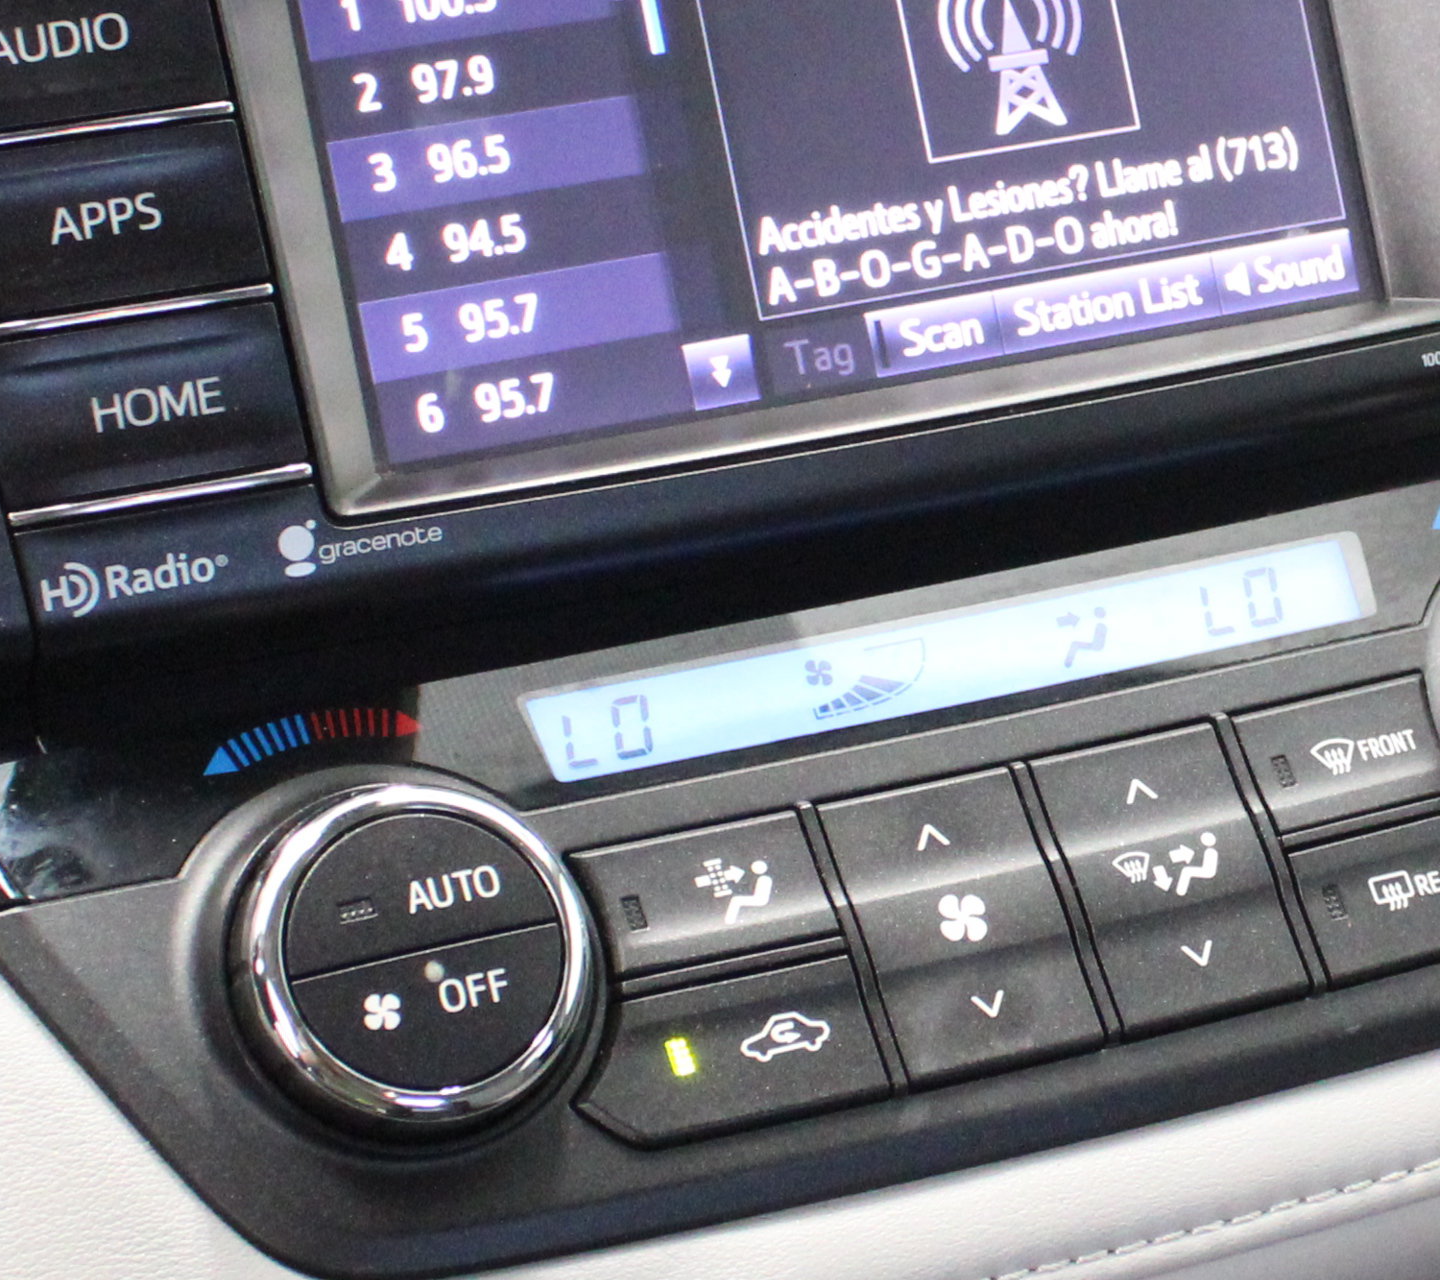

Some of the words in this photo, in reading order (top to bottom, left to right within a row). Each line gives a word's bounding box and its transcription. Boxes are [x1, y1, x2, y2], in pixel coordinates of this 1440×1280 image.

[352, 72, 384, 114] 2
[410, 53, 496, 105] 97.9
[367, 152, 398, 193] 3
[425, 133, 512, 184] 96.5
[758, 198, 920, 257] Accidentes
[924, 199, 944, 235] y
[947, 164, 1089, 224] Lesiones?
[1095, 157, 1184, 200] Llame
[1186, 144, 1213, 183] al
[1215, 125, 1300, 182] (713)
[50, 192, 163, 246] APPS
[384, 231, 415, 272] 4
[441, 213, 528, 264] 94.5
[766, 228, 1085, 307] A-B-O-G-A-D-O
[1090, 200, 1180, 251] ahora!
[1257, 250, 1346, 295] Sound
[400, 312, 429, 353] 5
[458, 292, 539, 344] 95.7
[1013, 282, 1137, 338] Station
[1140, 272, 1203, 314] List
[784, 336, 856, 378] Tag
[898, 313, 985, 358] Scan
[90, 377, 226, 433] HOME
[416, 392, 446, 434] 6
[473, 371, 555, 424] 95.7
[318, 521, 444, 564] gracenote
[1357, 729, 1417, 763] FRONT
[405, 863, 503, 916] AUTO
[438, 969, 510, 1016] OFF
